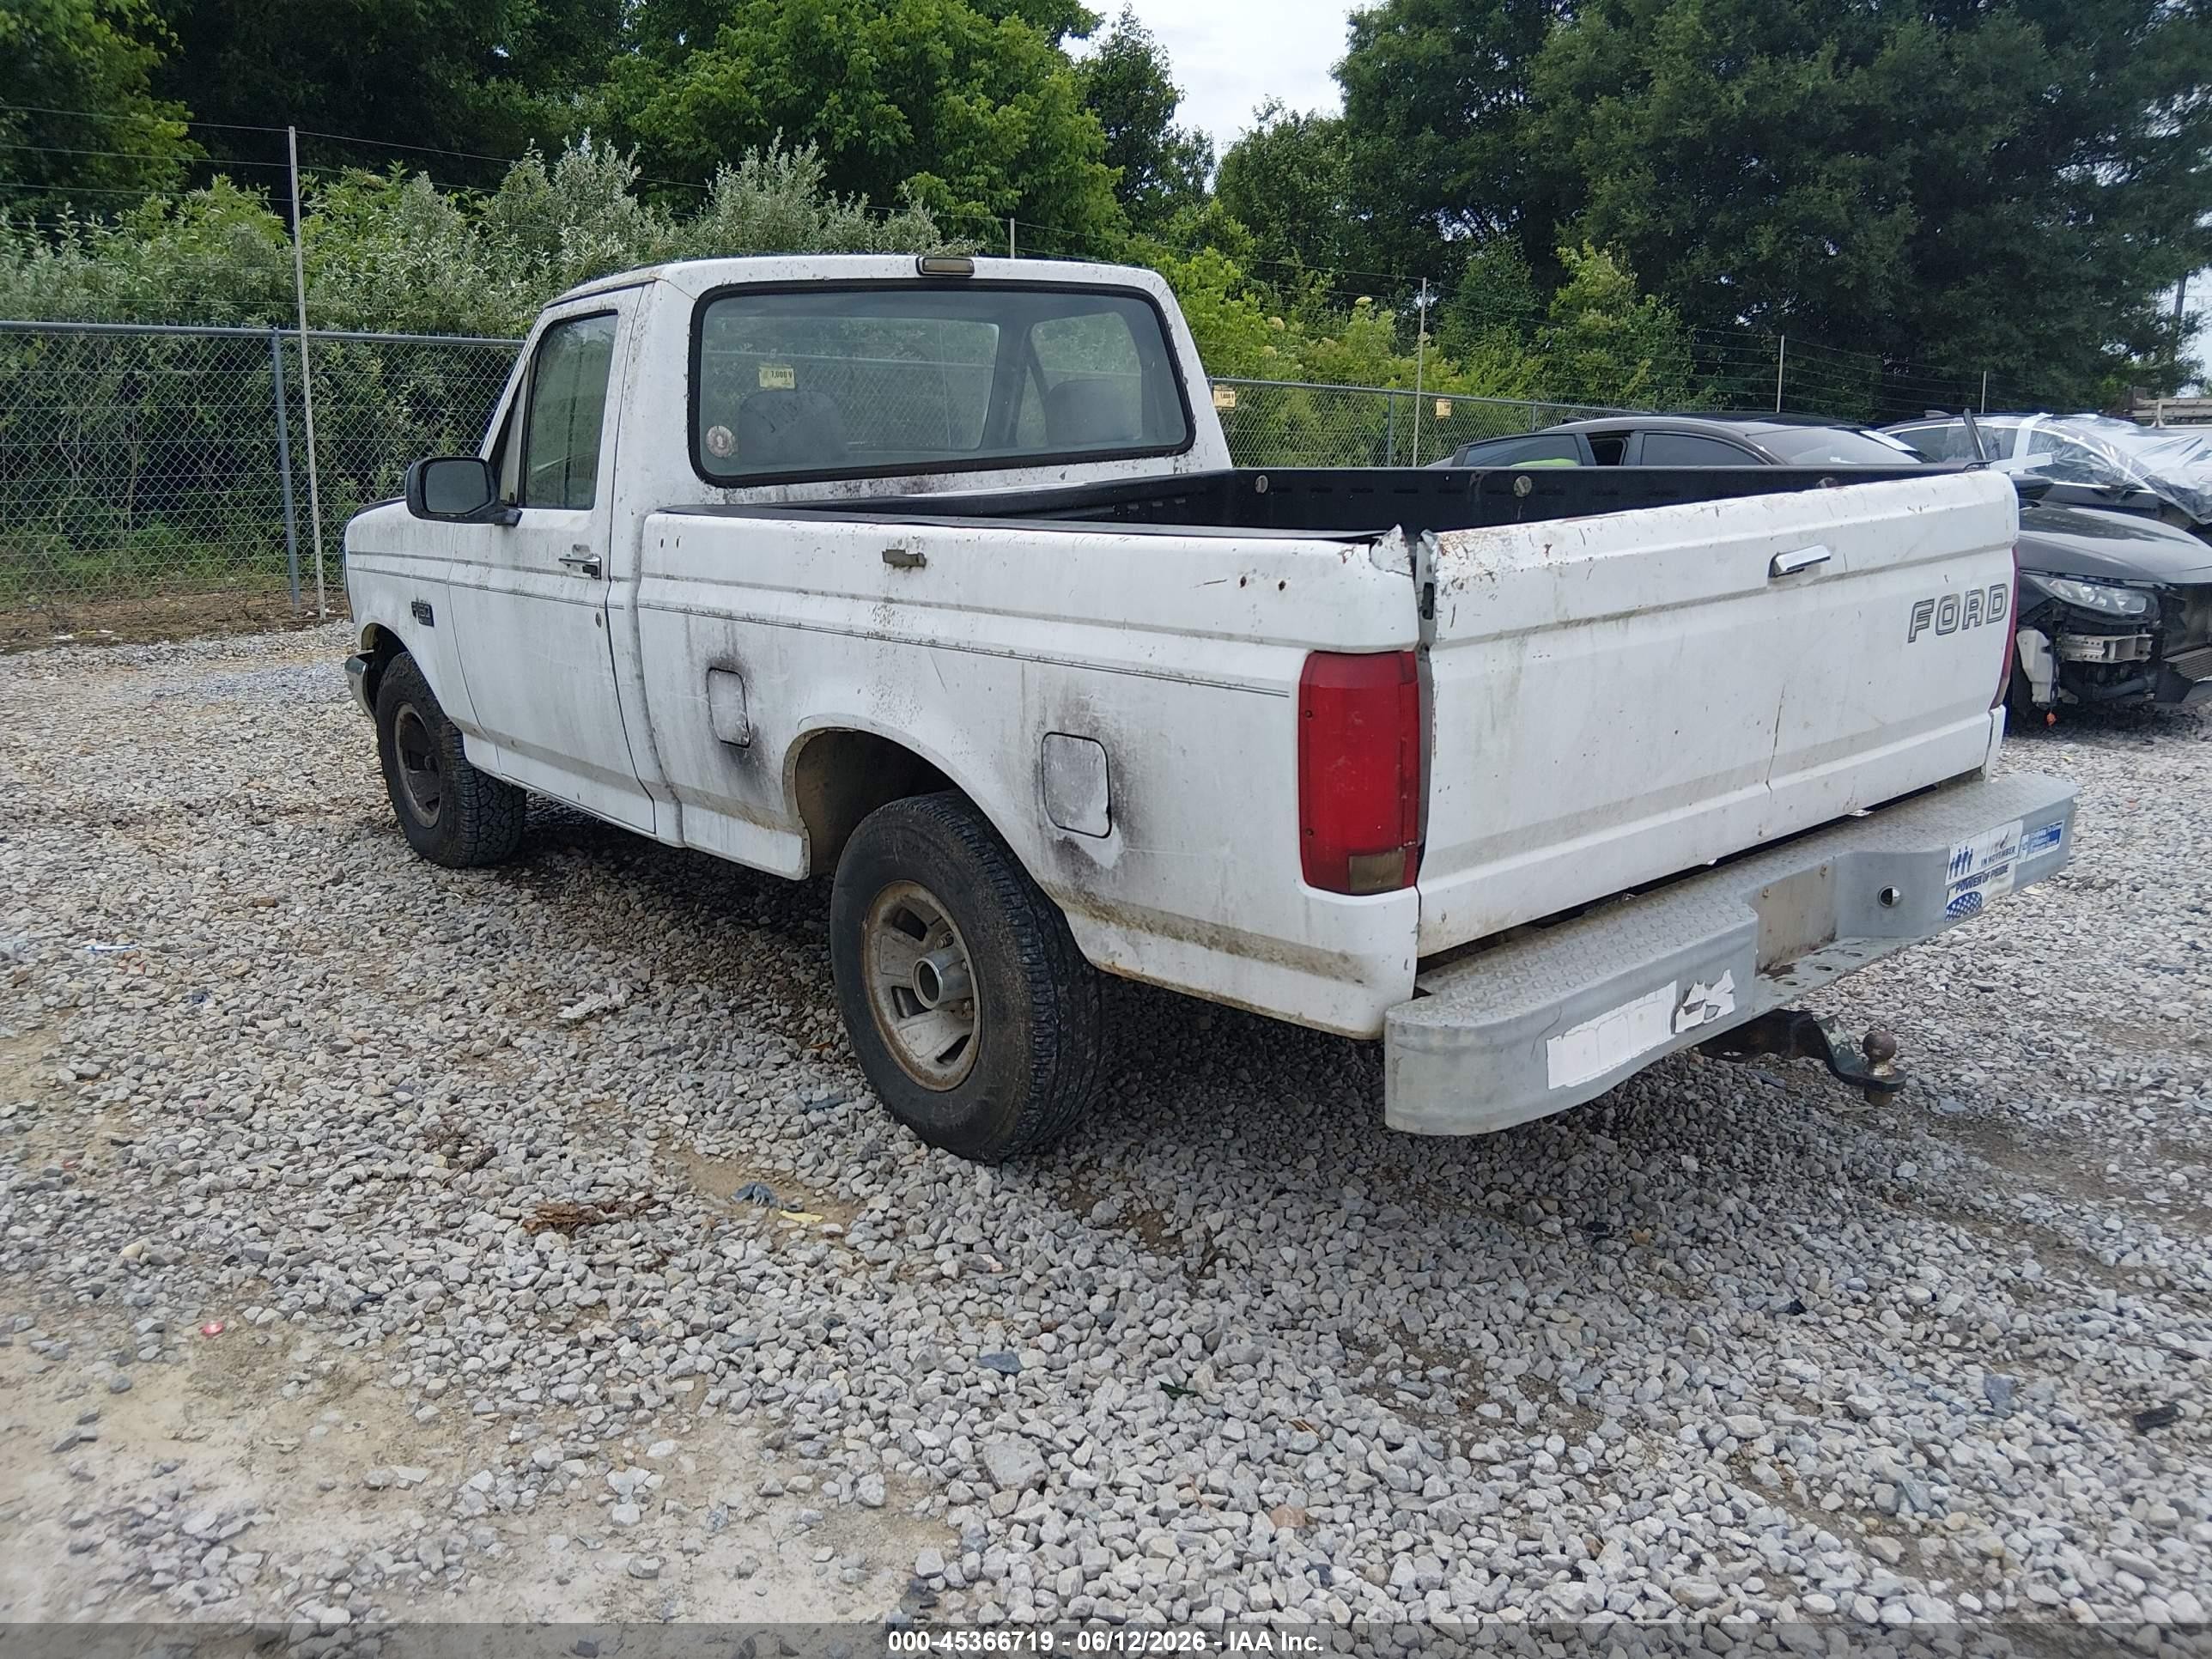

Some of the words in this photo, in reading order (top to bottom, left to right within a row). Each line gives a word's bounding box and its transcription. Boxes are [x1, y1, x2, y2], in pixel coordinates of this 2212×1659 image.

[1907, 583, 2008, 643] FORD
[1981, 857, 1988, 867] IN
[1988, 846, 2015, 865] NOVEMBER
[1955, 873, 1983, 893] POWER
[1983, 870, 1991, 884] OF
